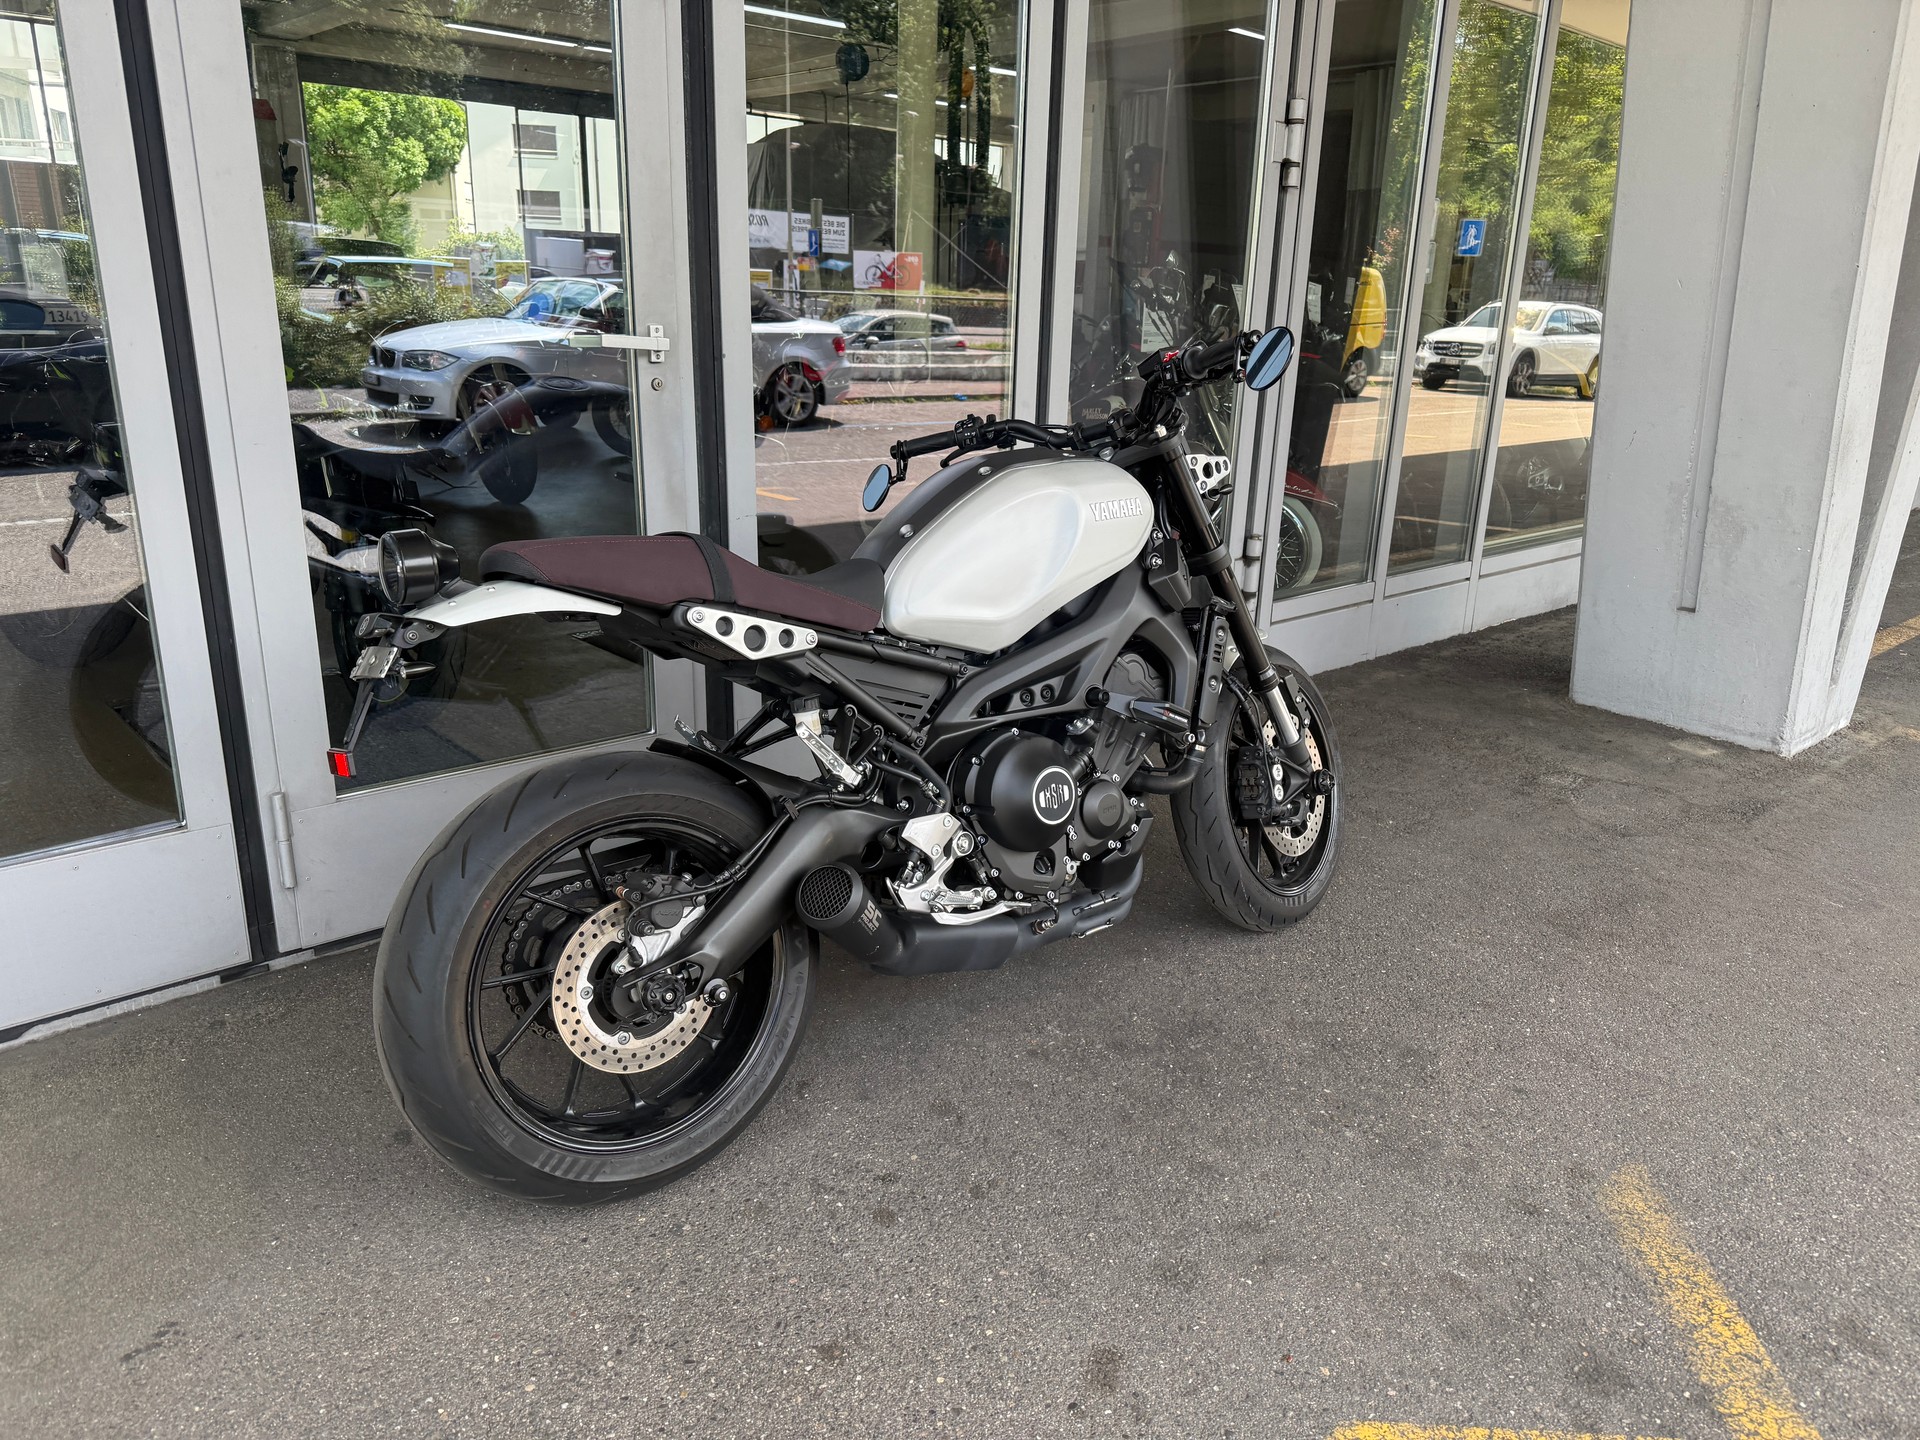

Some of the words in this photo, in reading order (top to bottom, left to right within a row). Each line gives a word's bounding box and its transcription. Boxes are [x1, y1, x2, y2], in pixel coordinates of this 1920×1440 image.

[1088, 497, 1143, 522] YAMAHA
[860, 913, 877, 932] PROJECT
[863, 899, 882, 928] SC
